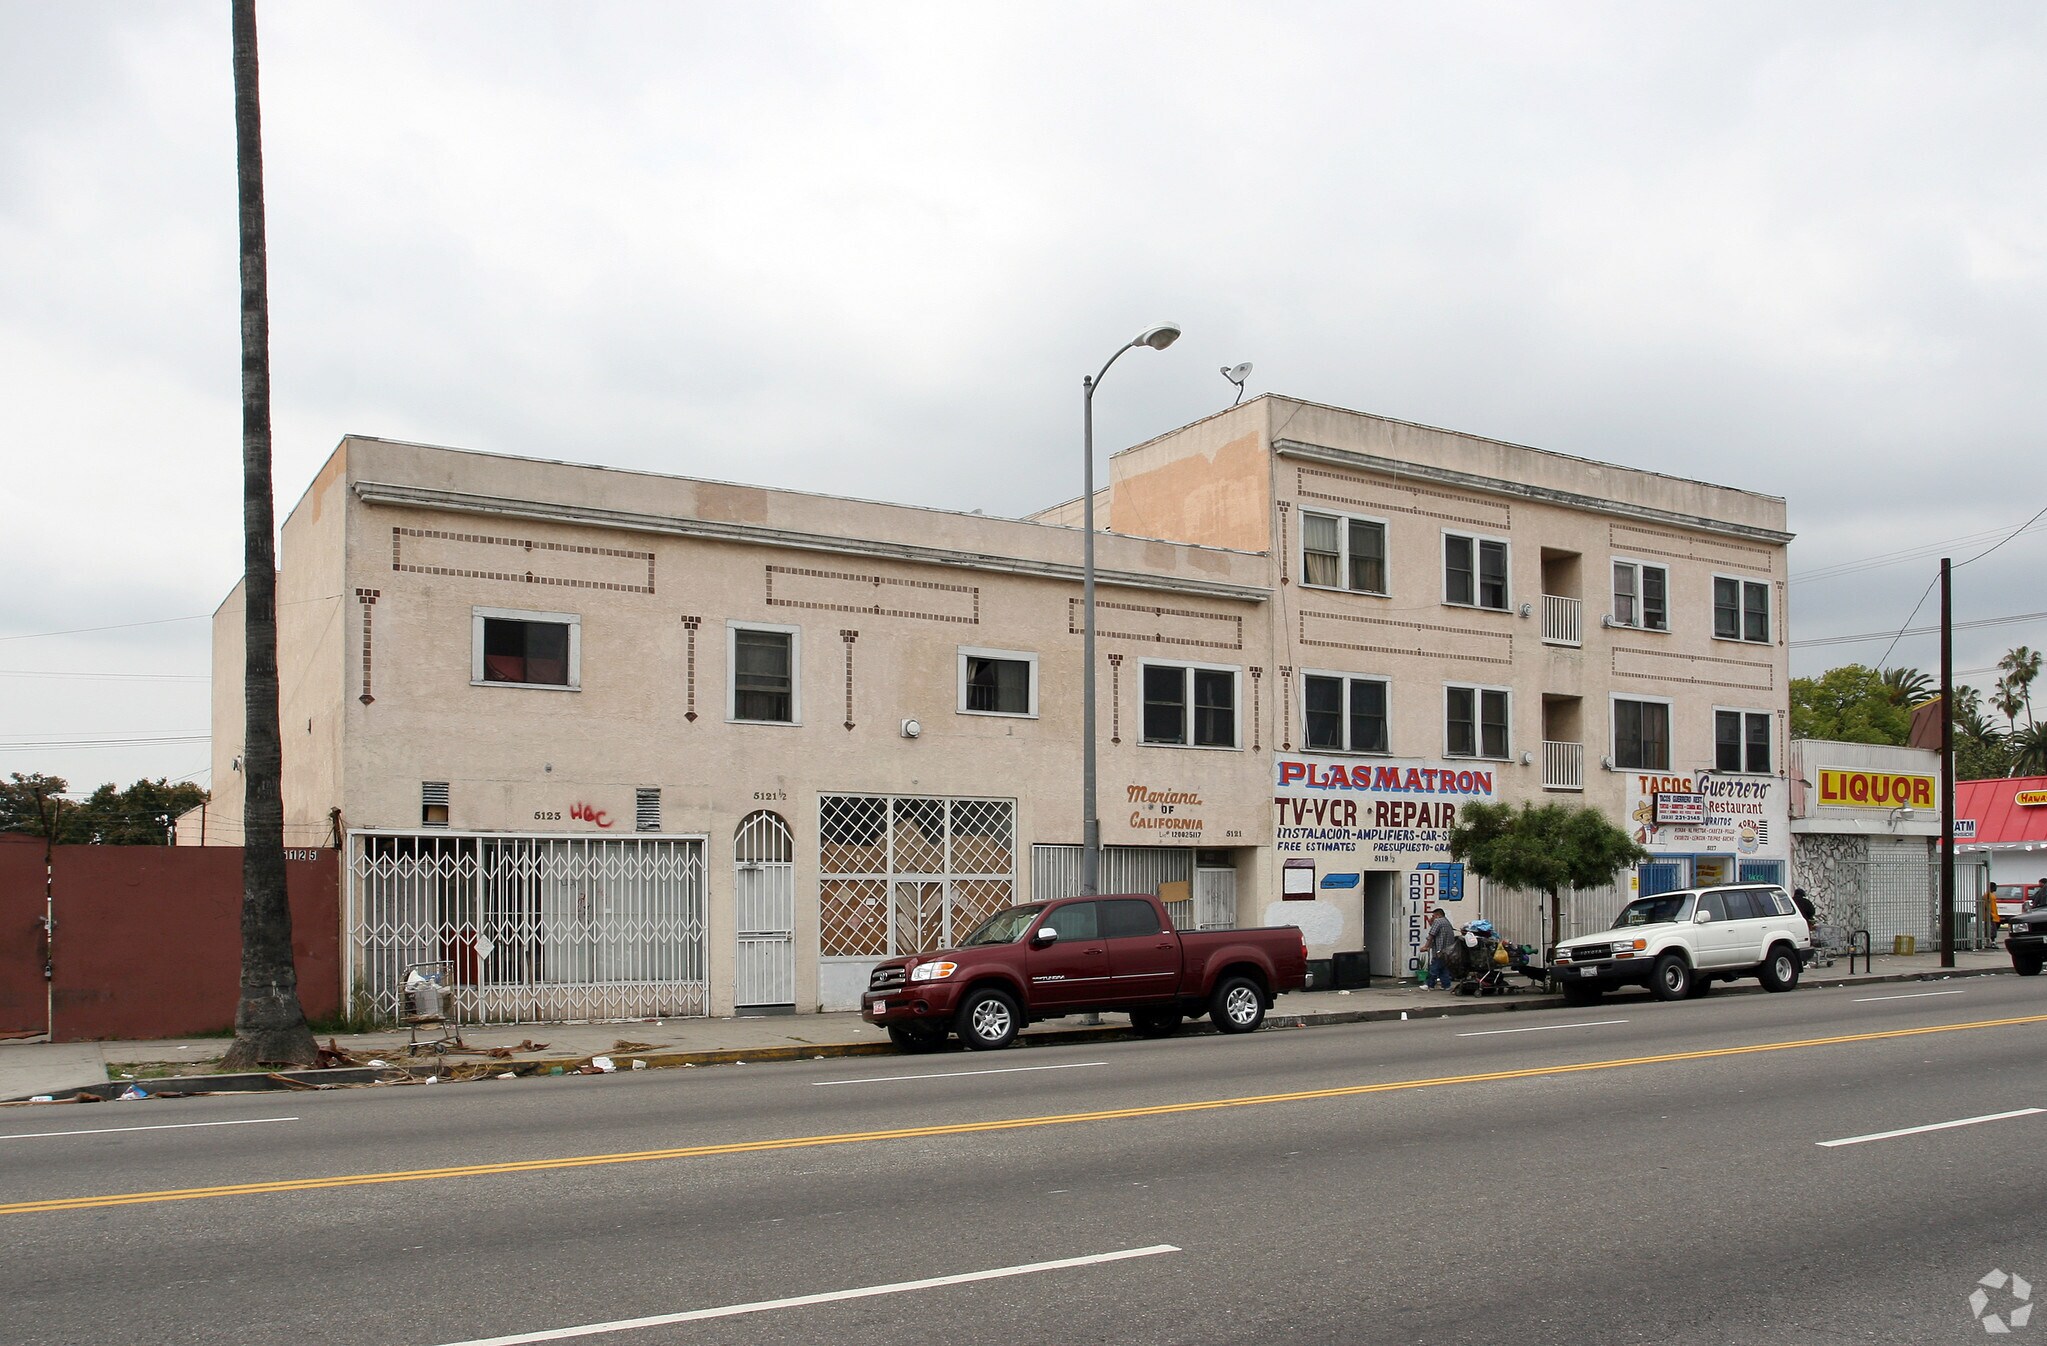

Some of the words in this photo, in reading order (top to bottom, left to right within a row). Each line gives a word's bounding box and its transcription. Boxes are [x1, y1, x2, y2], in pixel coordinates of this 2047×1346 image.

[1277, 761, 1493, 796] PLASMATRON
[1639, 776, 1692, 794] TACOS
[1699, 775, 1771, 799] Guerrero
[1821, 773, 1931, 804] LIQUOR
[753, 791, 777, 800] 5121
[1126, 784, 1203, 806] Mariana
[534, 811, 561, 821] 5123
[1161, 805, 1175, 815] OF
[1274, 797, 1357, 827] TV-VCR
[1375, 800, 1456, 829] REPAIR
[1709, 800, 1763, 815] Restaurant
[1129, 811, 1203, 830] CALIFORNIA
[1954, 820, 1974, 832] ATM
[1277, 841, 1301, 851] FREE
[1306, 841, 1356, 852] ESTIMATES
[1424, 873, 1435, 930] OPEN
[1409, 873, 1421, 971] ABIERTO
